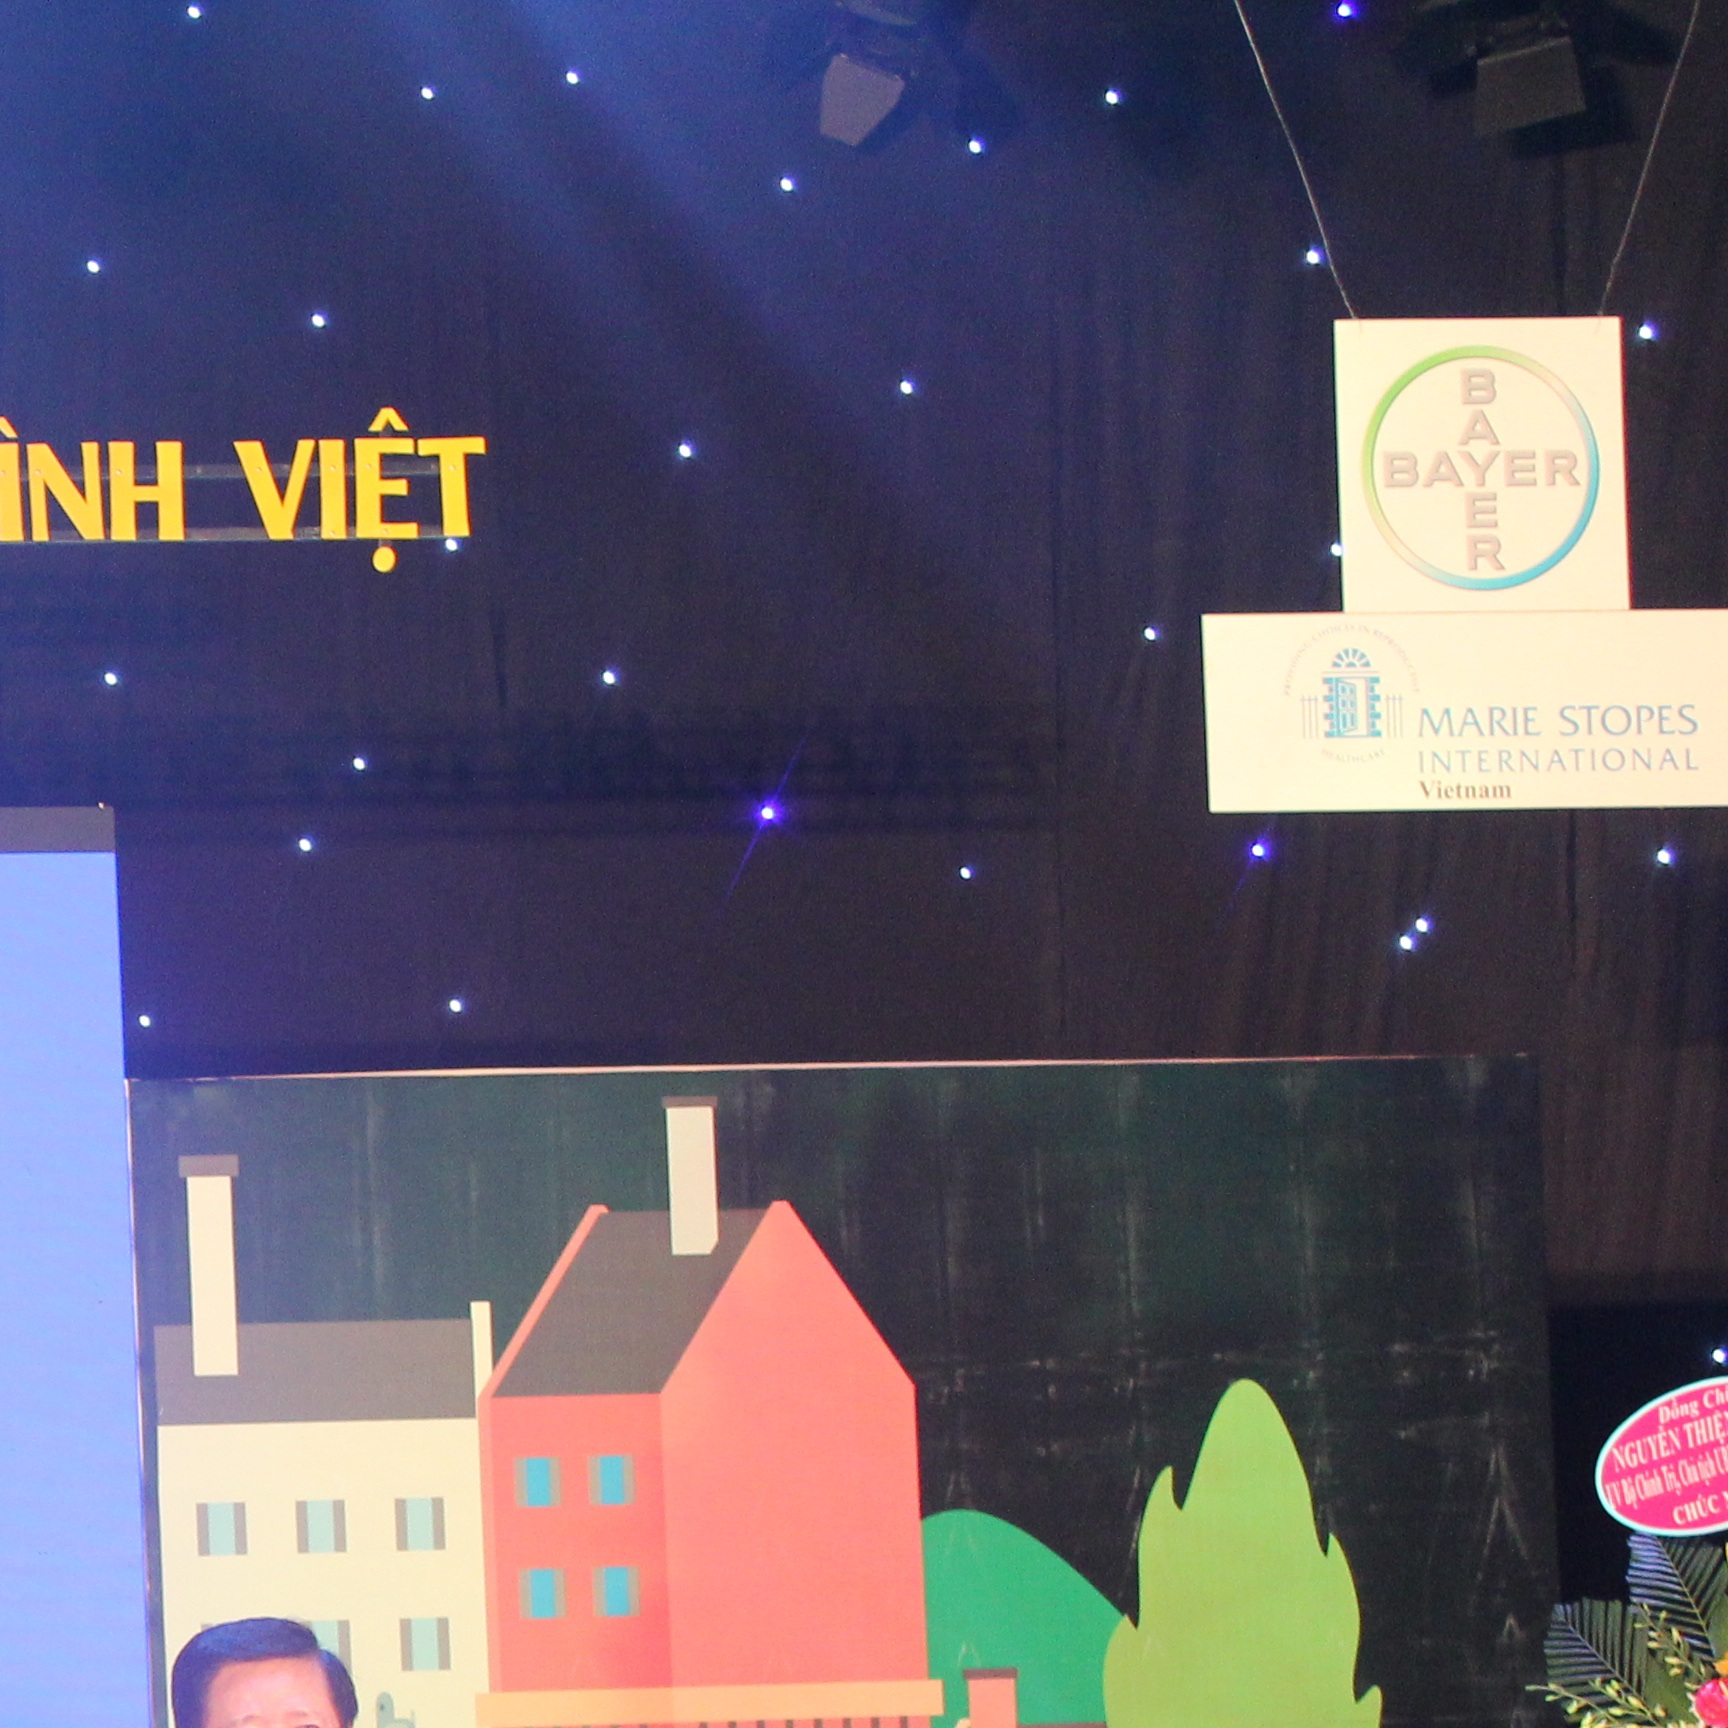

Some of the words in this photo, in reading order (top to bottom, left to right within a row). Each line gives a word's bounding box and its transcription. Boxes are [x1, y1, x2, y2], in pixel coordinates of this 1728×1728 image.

[1383, 449, 1581, 489] BAYER
[233, 406, 487, 573] VIỆT
[1417, 706, 1542, 738] MARIE
[1559, 703, 1700, 736] STOPES
[1418, 747, 1700, 774] INTERNATIONAL
[1418, 780, 1513, 800] Vietnam
